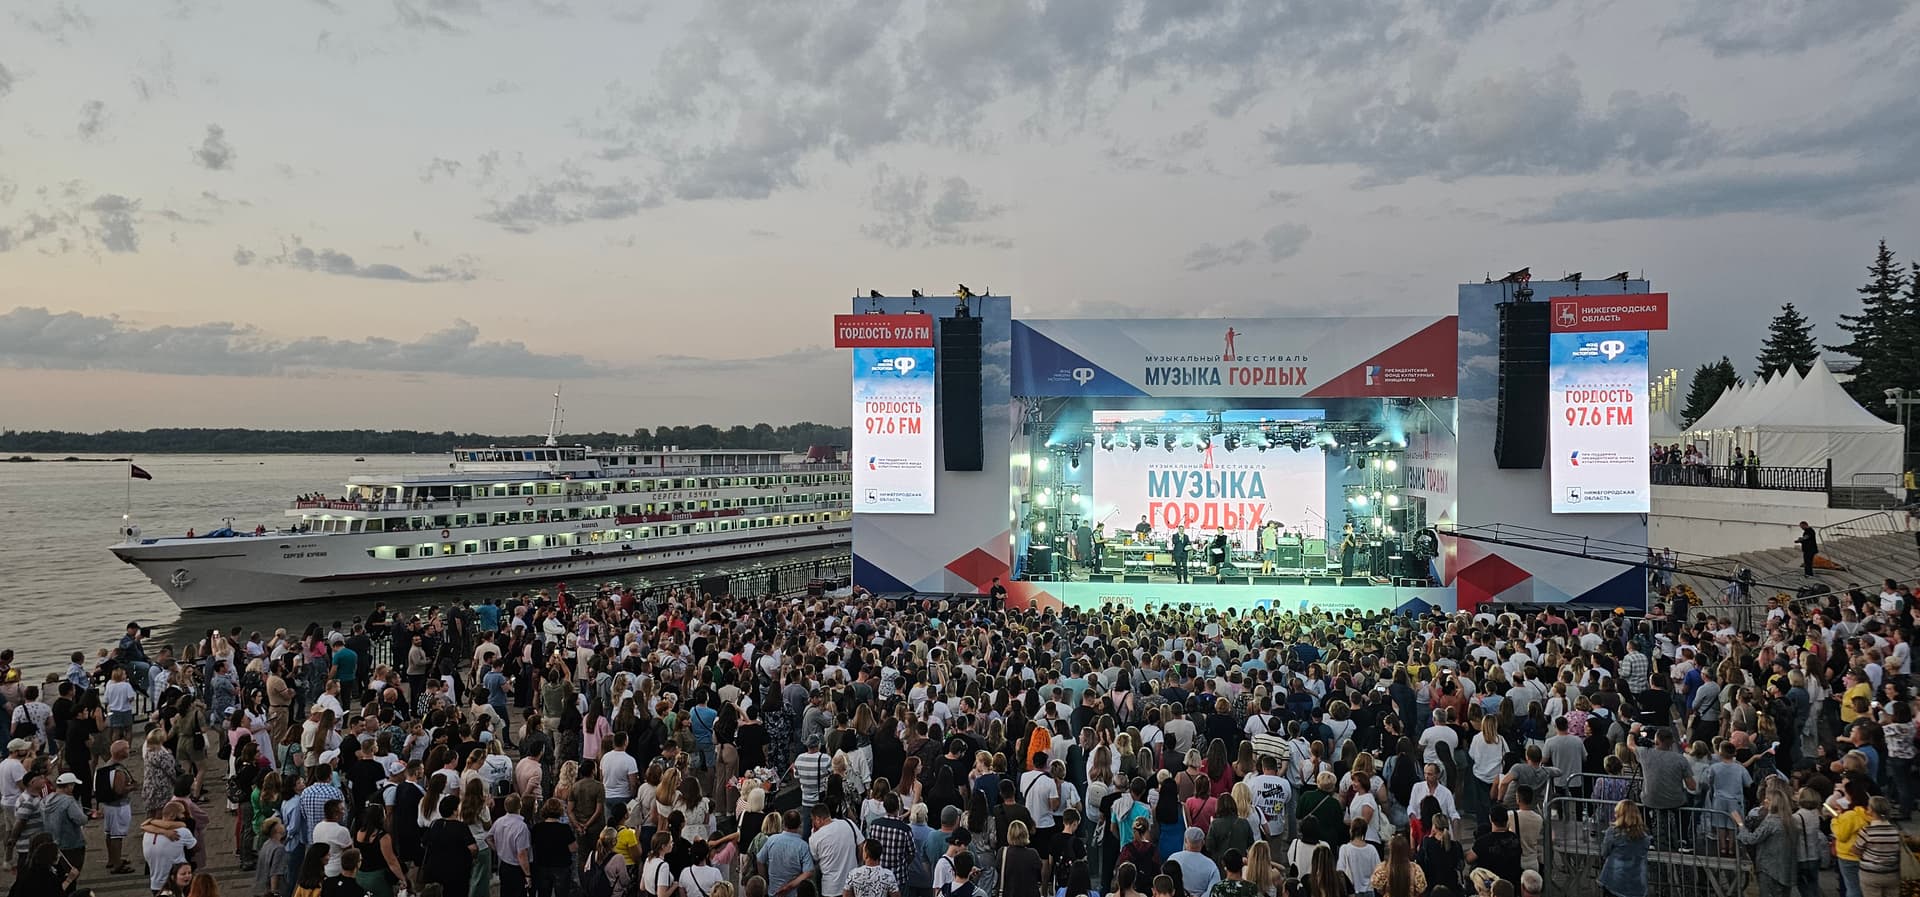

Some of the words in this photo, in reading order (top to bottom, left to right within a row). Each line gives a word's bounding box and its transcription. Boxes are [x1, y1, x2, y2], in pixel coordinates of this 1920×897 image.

[1581, 305, 1657, 314] НИЖЕГОРОДСКАЯ
[1581, 315, 1621, 323] ОБЛАСТЬ
[840, 327, 891, 339] ГОРДОСТЬ
[894, 327, 913, 339] 97.6
[915, 327, 929, 339] FM
[1145, 354, 1221, 362] МУЗЫКАЛЬНЫЙ
[1145, 367, 1222, 386] МУЗЫКА
[1229, 367, 1308, 386] ГОРДЫХ
[1565, 389, 1633, 403] ГОРДОСТЬ
[865, 401, 922, 414] ГОРДОСТЬ
[1565, 407, 1602, 426] 97.6
[1606, 406, 1633, 426] FM
[865, 416, 896, 434] 97.6
[899, 416, 921, 434] FM
[1148, 470, 1266, 499] МУЗЫКА
[1149, 502, 1265, 530] ГОРДЫХ
